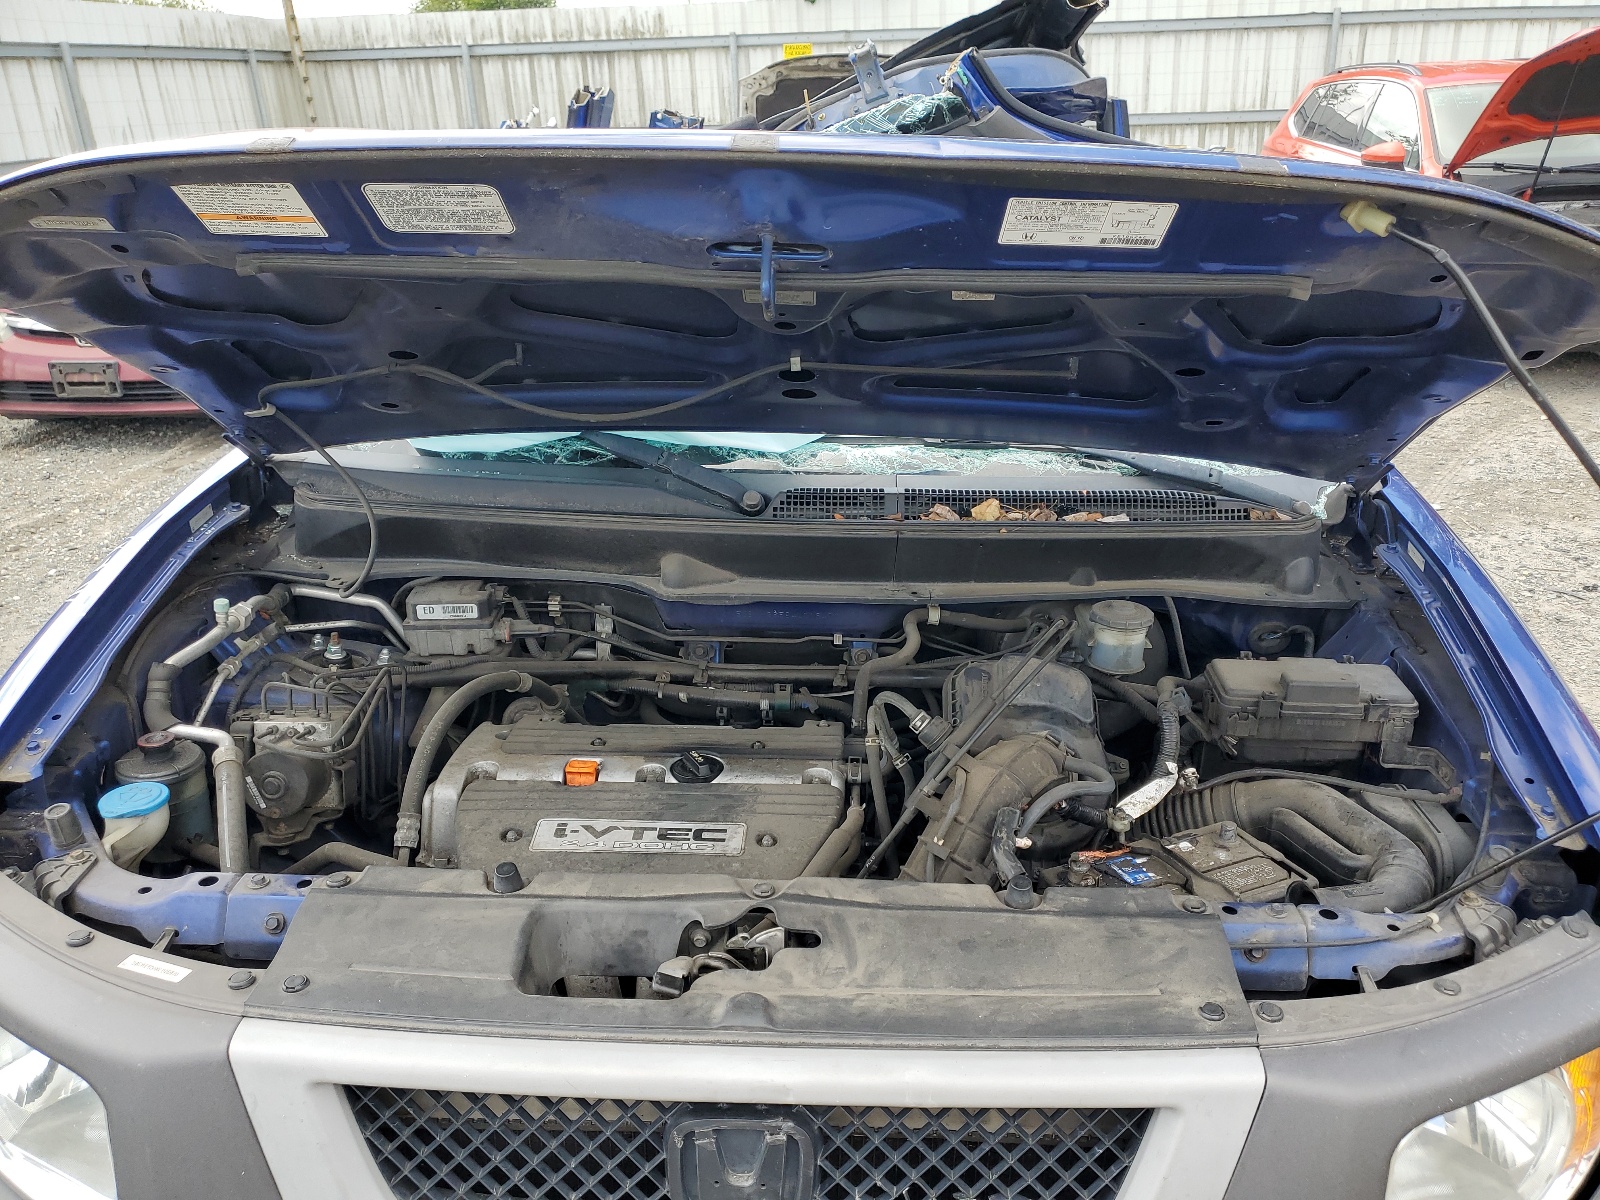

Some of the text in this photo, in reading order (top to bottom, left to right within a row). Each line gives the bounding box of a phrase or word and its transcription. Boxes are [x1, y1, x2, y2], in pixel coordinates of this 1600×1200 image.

[423, 606, 435, 615] ED
[553, 822, 728, 843] i-VTEC
[559, 839, 716, 851] 2.4 DOHC
